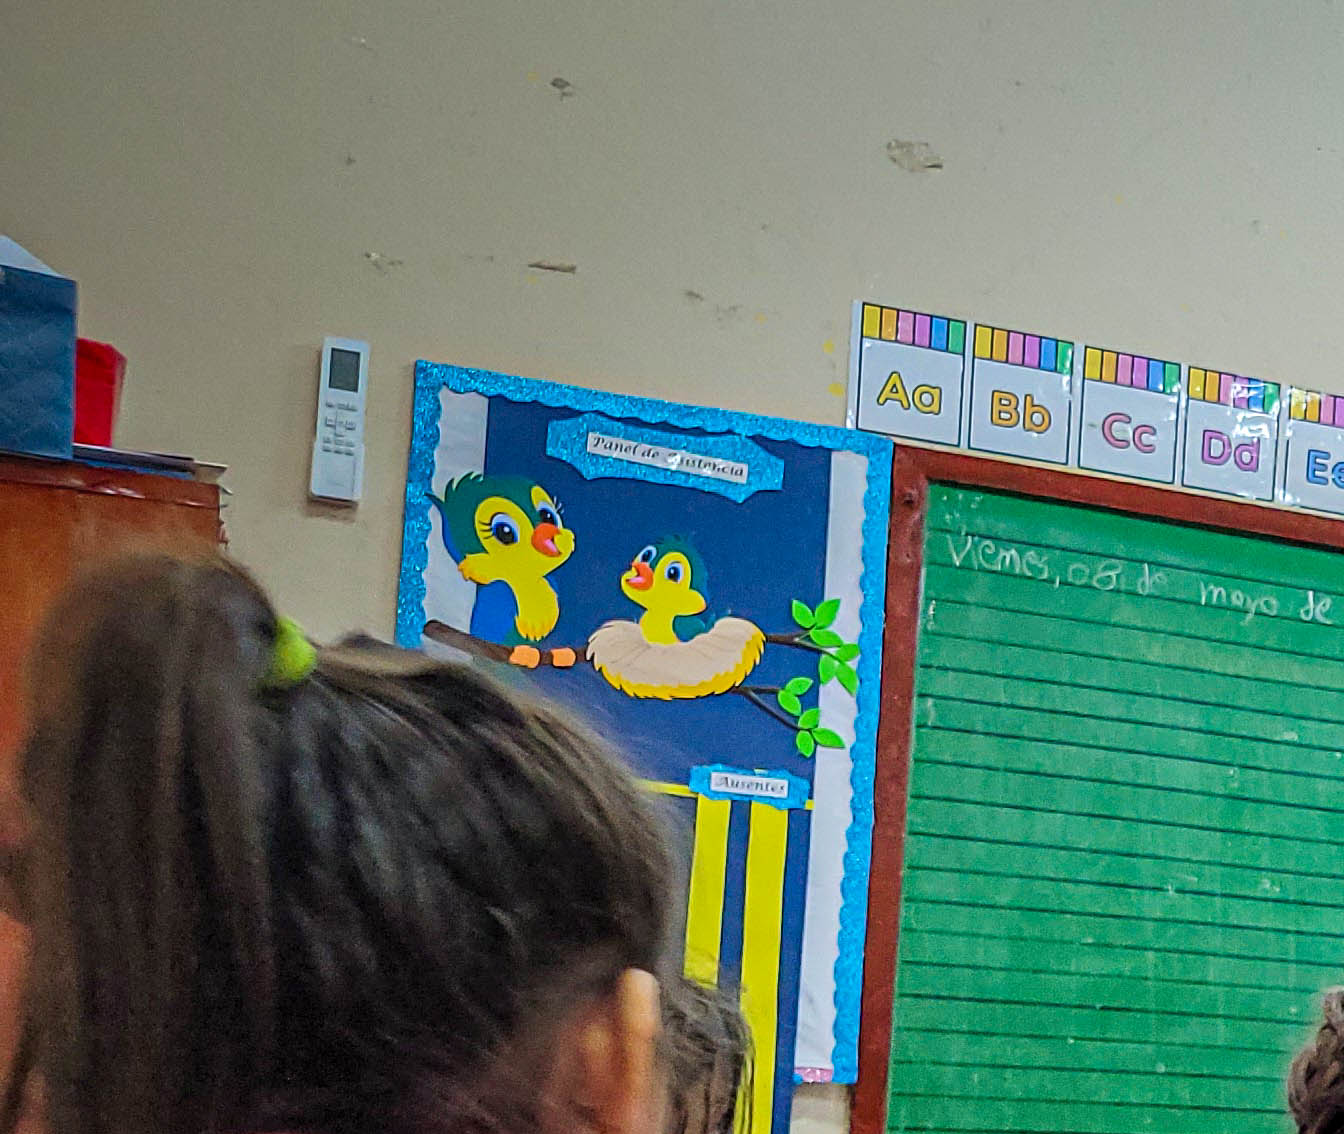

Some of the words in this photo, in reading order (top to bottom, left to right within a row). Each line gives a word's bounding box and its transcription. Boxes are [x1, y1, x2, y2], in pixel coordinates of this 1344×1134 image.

[877, 372, 941, 414] Aa
[991, 390, 1051, 433] Bb
[1101, 412, 1157, 453] Cc
[1200, 429, 1260, 472] Dd
[592, 436, 638, 456] Panel
[641, 447, 660, 460] de
[667, 452, 744, 477] sistencia
[1300, 591, 1334, 624] de
